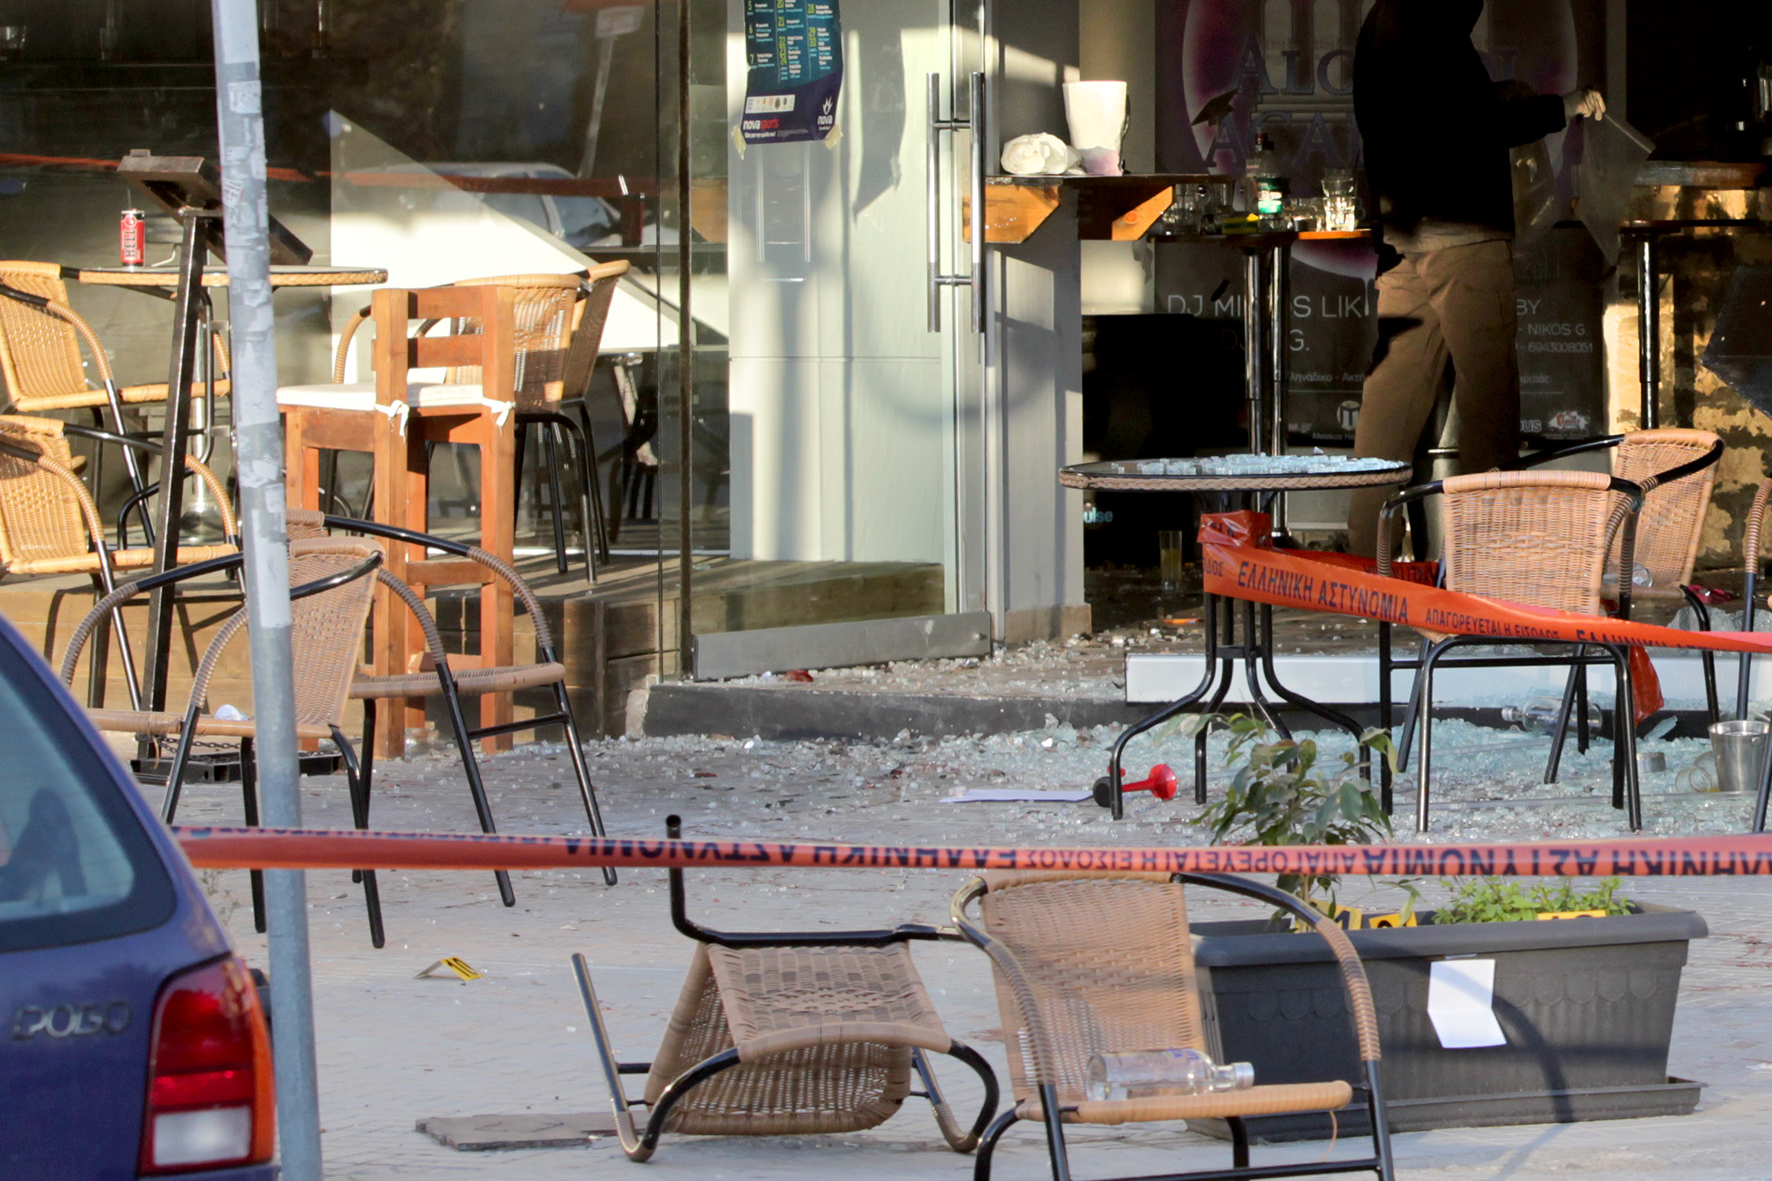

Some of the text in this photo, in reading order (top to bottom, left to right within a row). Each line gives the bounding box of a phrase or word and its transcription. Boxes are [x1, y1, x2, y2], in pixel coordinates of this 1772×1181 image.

[1528, 323, 1571, 336] NIKOS
[1238, 562, 1313, 602] ΕΛΛΗΝΙΚΗ
[1318, 580, 1409, 623] ΑΣΤΥΝΟΜΙΑ
[1425, 607, 1502, 636] ΑΠΑΓΟΡΕΥΕΤΑΙ
[813, 845, 1016, 869] ΕΛΛΗΝΙΚΗ
[1025, 849, 1133, 871] ΕΙΣΟΔΟΣ
[1141, 850, 1158, 871] Η
[1166, 850, 1358, 874] ΑΠΑΓΟΡΕΥΕΤΑΙ
[1361, 848, 1599, 876] ΑΣΤΥΝΟΜΙΑ
